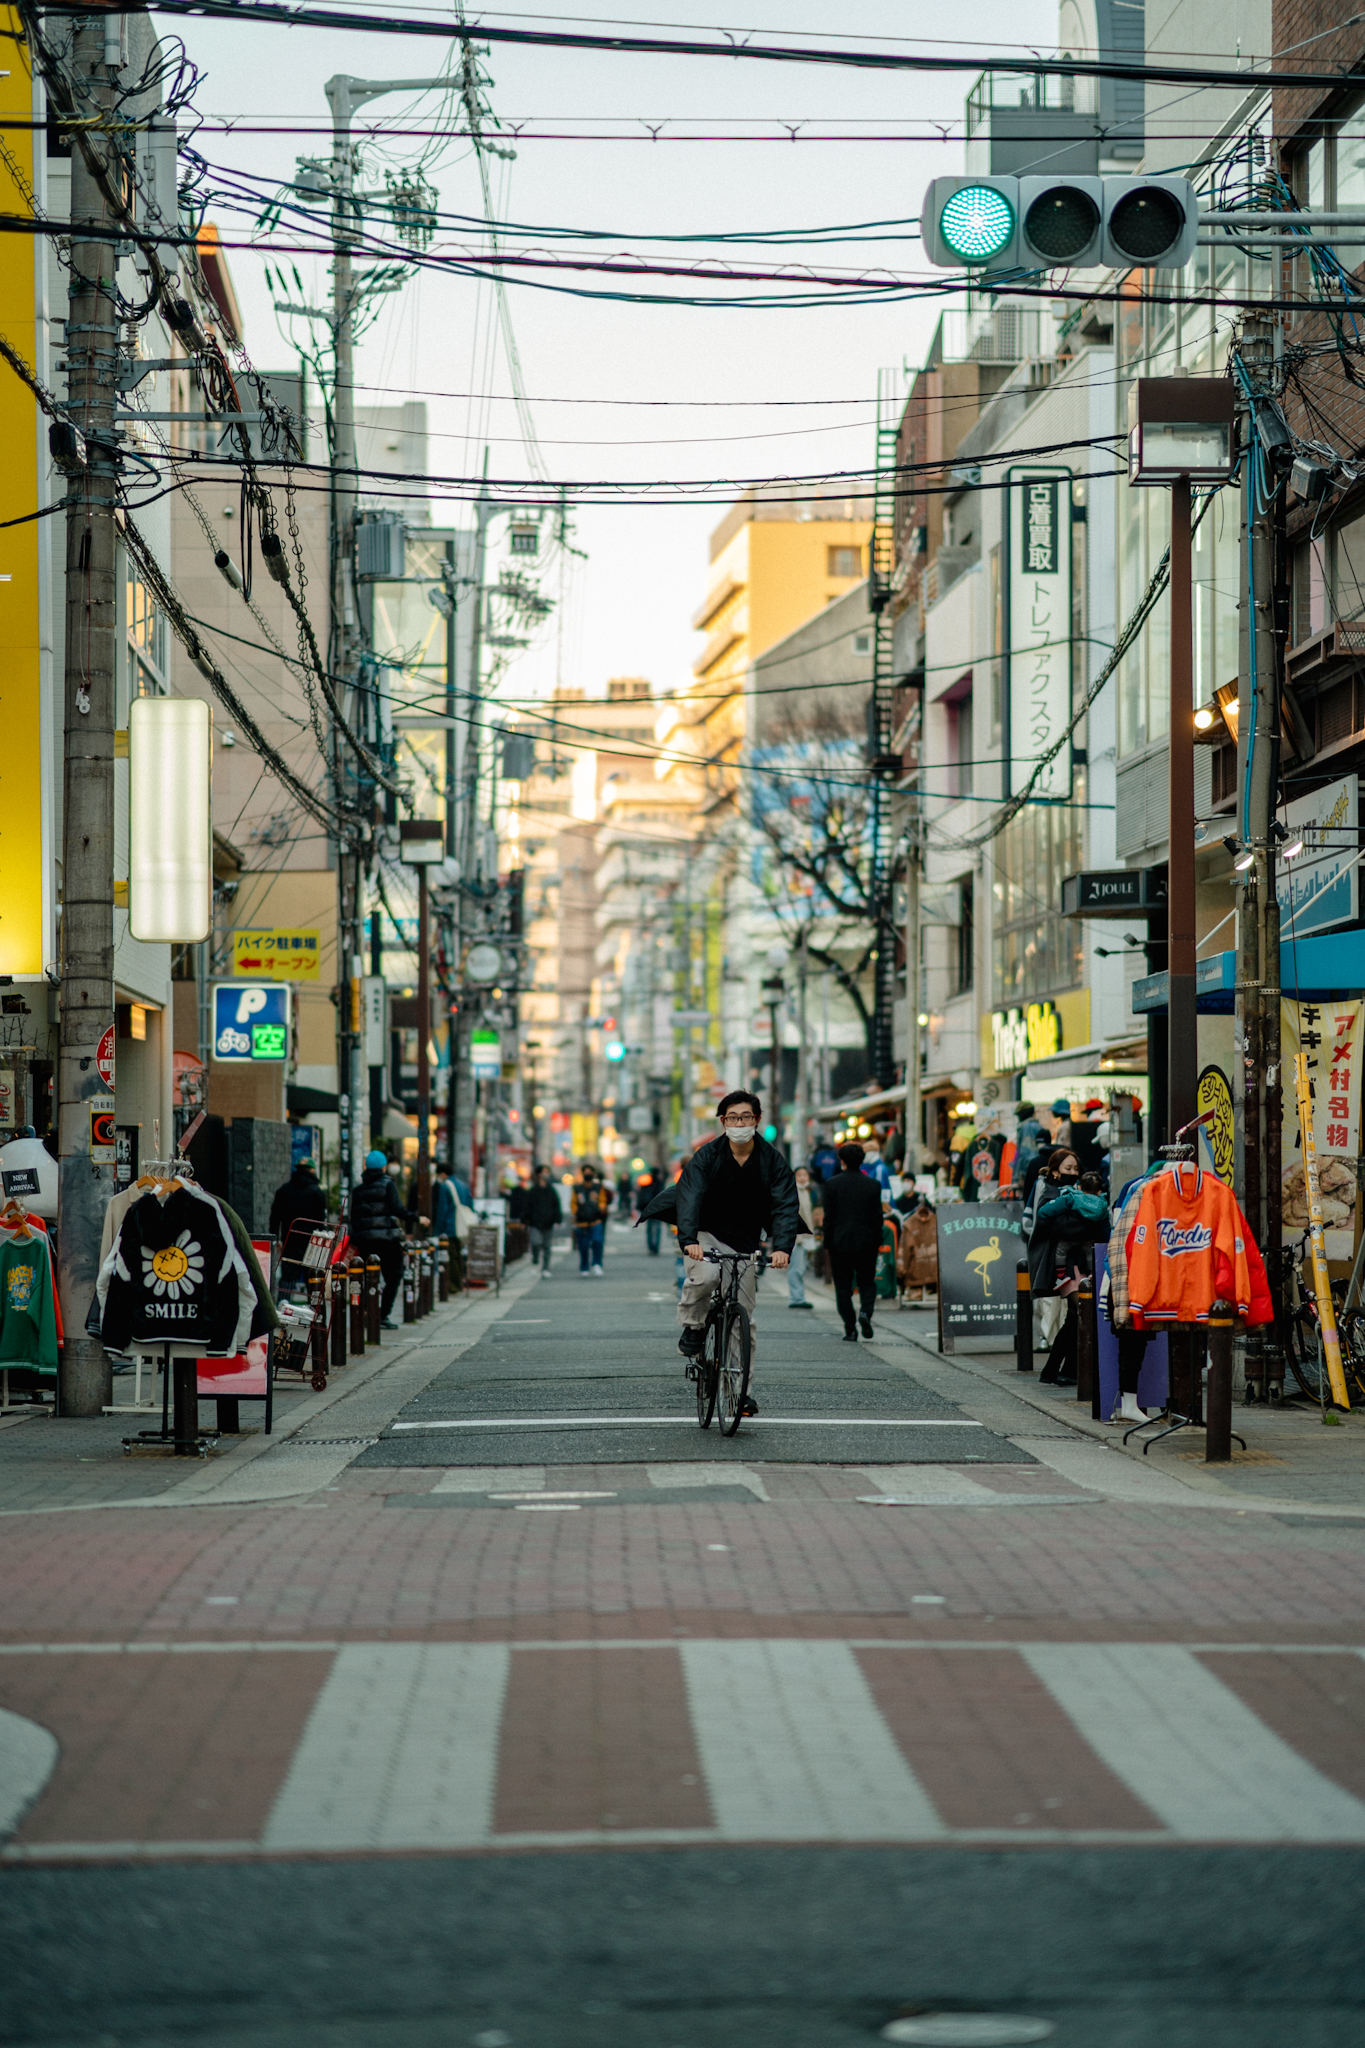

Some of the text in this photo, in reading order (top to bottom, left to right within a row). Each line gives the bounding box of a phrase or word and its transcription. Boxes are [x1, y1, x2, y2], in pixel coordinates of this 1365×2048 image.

[1028, 480, 1052, 571] 古着買取
[1030, 580, 1052, 794] トレファクスタル
[1102, 882, 1134, 897] JOULE
[238, 937, 317, 950] バイク駐車場
[264, 957, 317, 971] オープン
[236, 988, 267, 1024] P
[252, 1024, 286, 1058] 空
[1326, 1015, 1356, 1148] アメ村名物
[10, 1184, 35, 1192] ARRIVAL
[942, 1217, 1021, 1235] FLORIDA
[144, 1303, 198, 1319] SMILE
